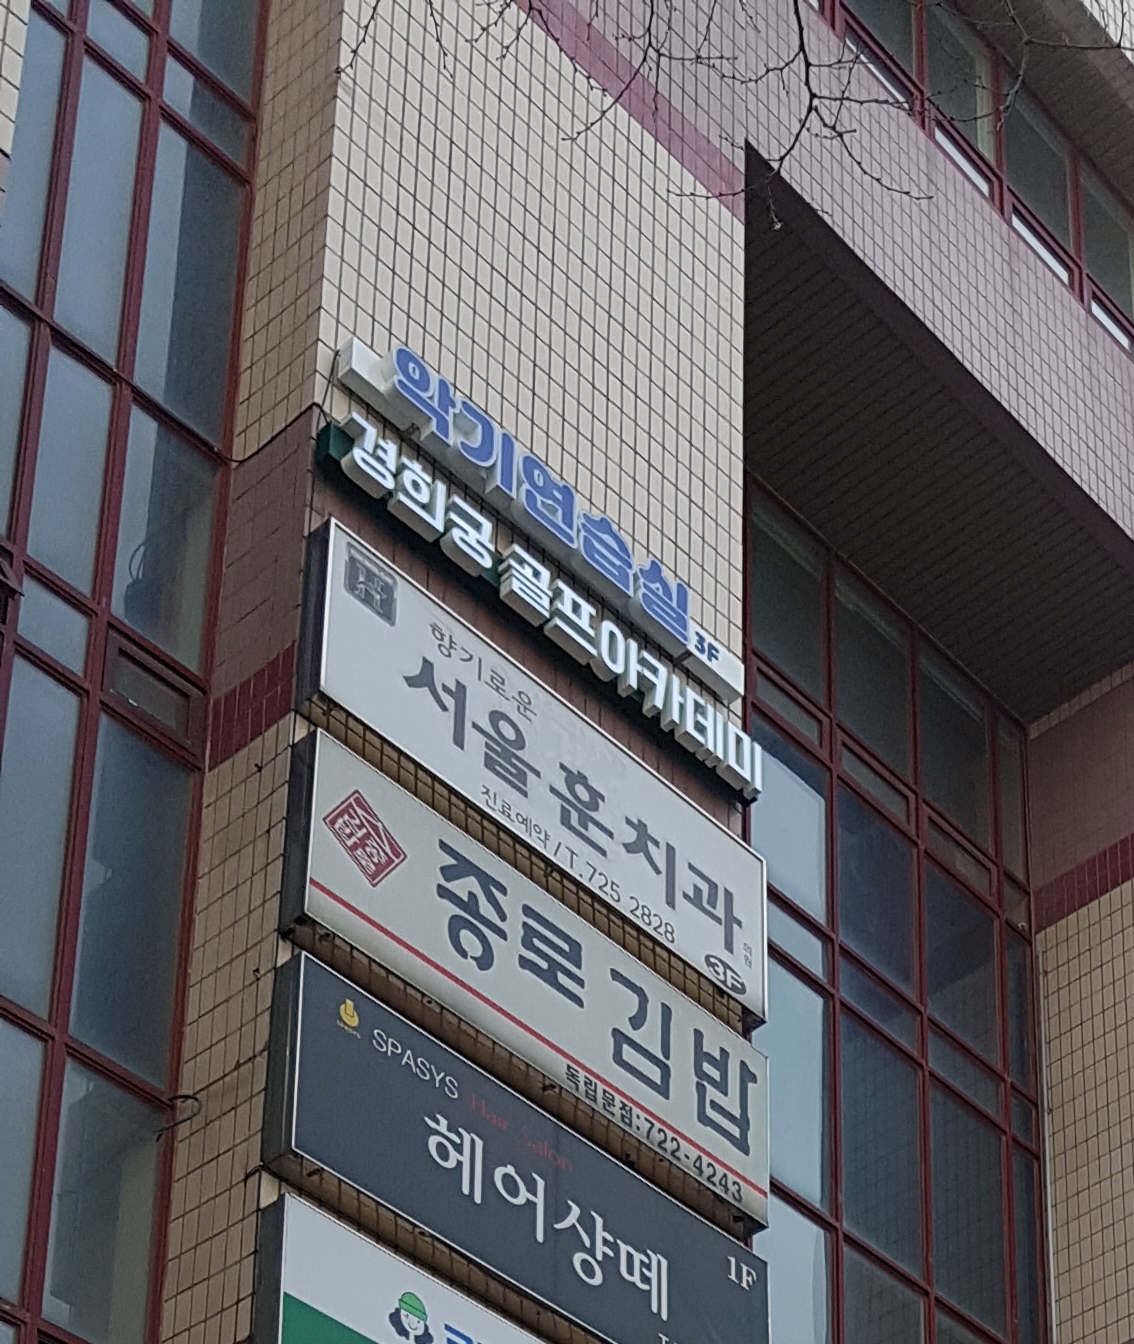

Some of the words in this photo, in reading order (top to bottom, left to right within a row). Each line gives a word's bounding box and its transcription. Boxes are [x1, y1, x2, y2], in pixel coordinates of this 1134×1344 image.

[394, 347, 691, 645] 악기연습실
[694, 631, 720, 663] 3F
[347, 412, 497, 571] 경희궁
[503, 543, 762, 797] 골프아카데미
[429, 622, 537, 722] 향기로운
[481, 784, 550, 850] 진료예약
[629, 896, 675, 943] 2828
[708, 956, 743, 992] 3F
[371, 1029, 459, 1099] SPASYS
[424, 1113, 668, 1322] 헤어샹떼
[726, 1255, 757, 1290] 1F
